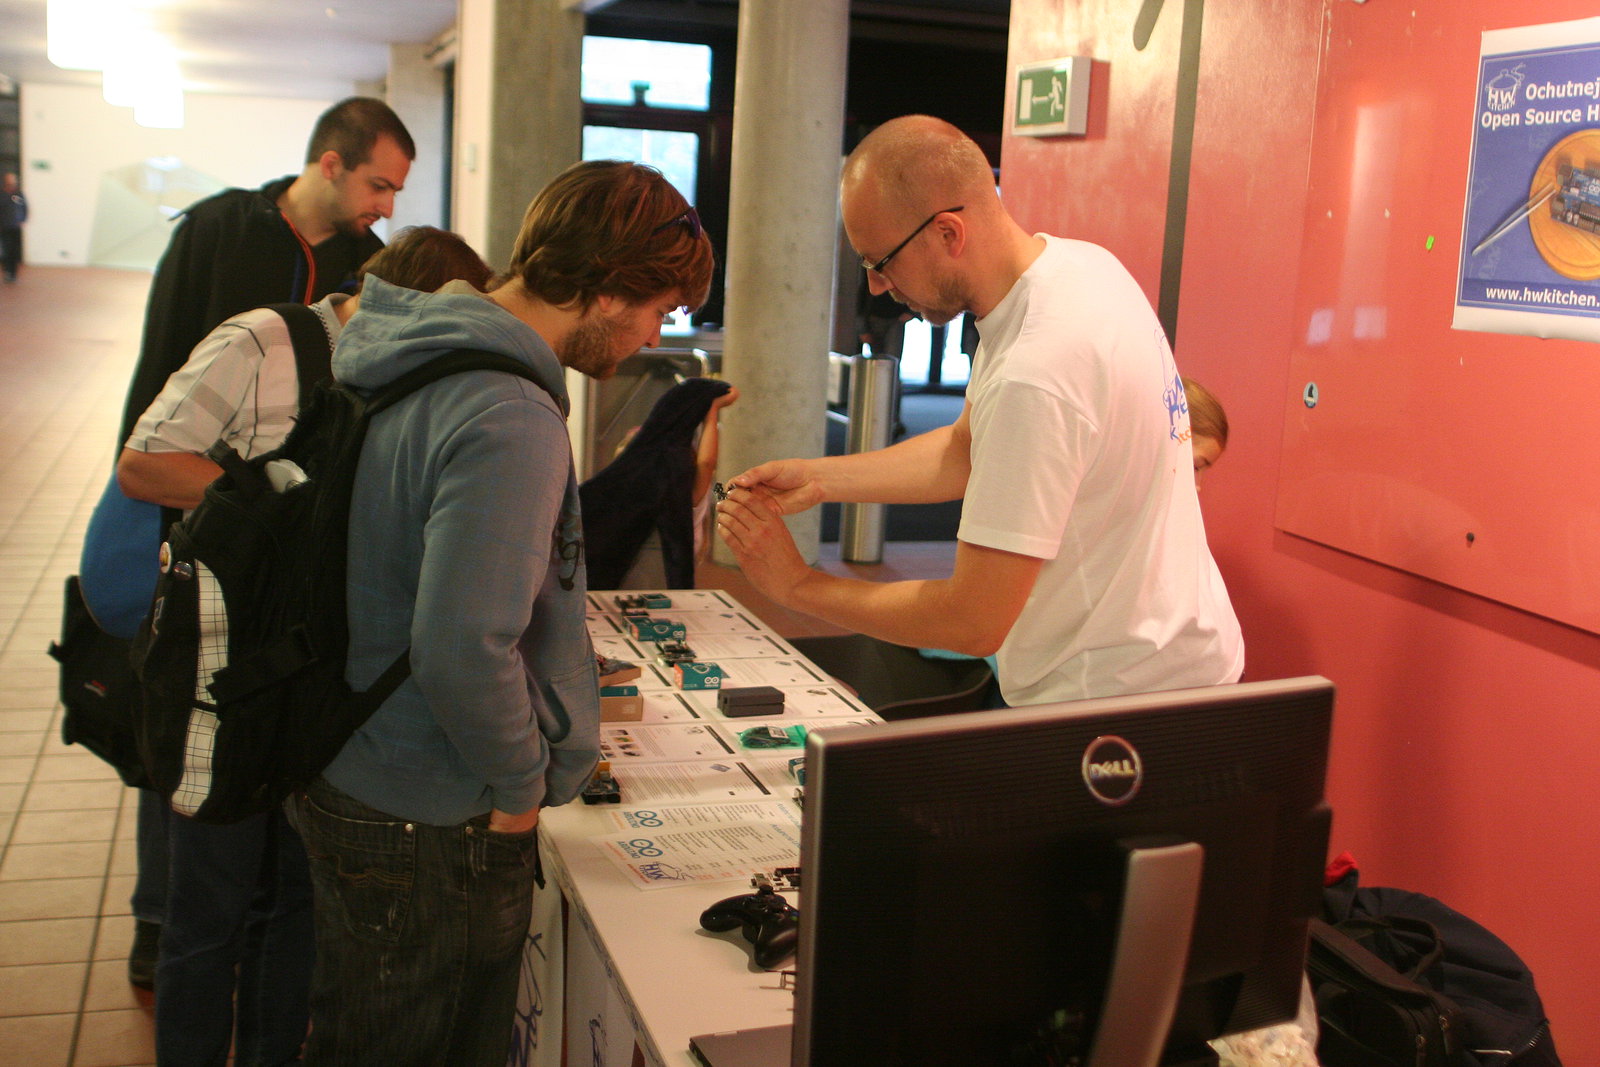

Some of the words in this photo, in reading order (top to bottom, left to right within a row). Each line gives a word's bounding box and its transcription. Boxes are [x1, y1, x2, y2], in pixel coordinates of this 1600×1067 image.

[1488, 86, 1516, 105] HW
[1525, 77, 1600, 100] Ochutnej
[1481, 111, 1520, 131] Open
[1524, 107, 1581, 125] Source
[1587, 104, 1600, 122] H
[1486, 286, 1600, 307] www.hwkitchen.
[1089, 759, 1135, 778] DELL
